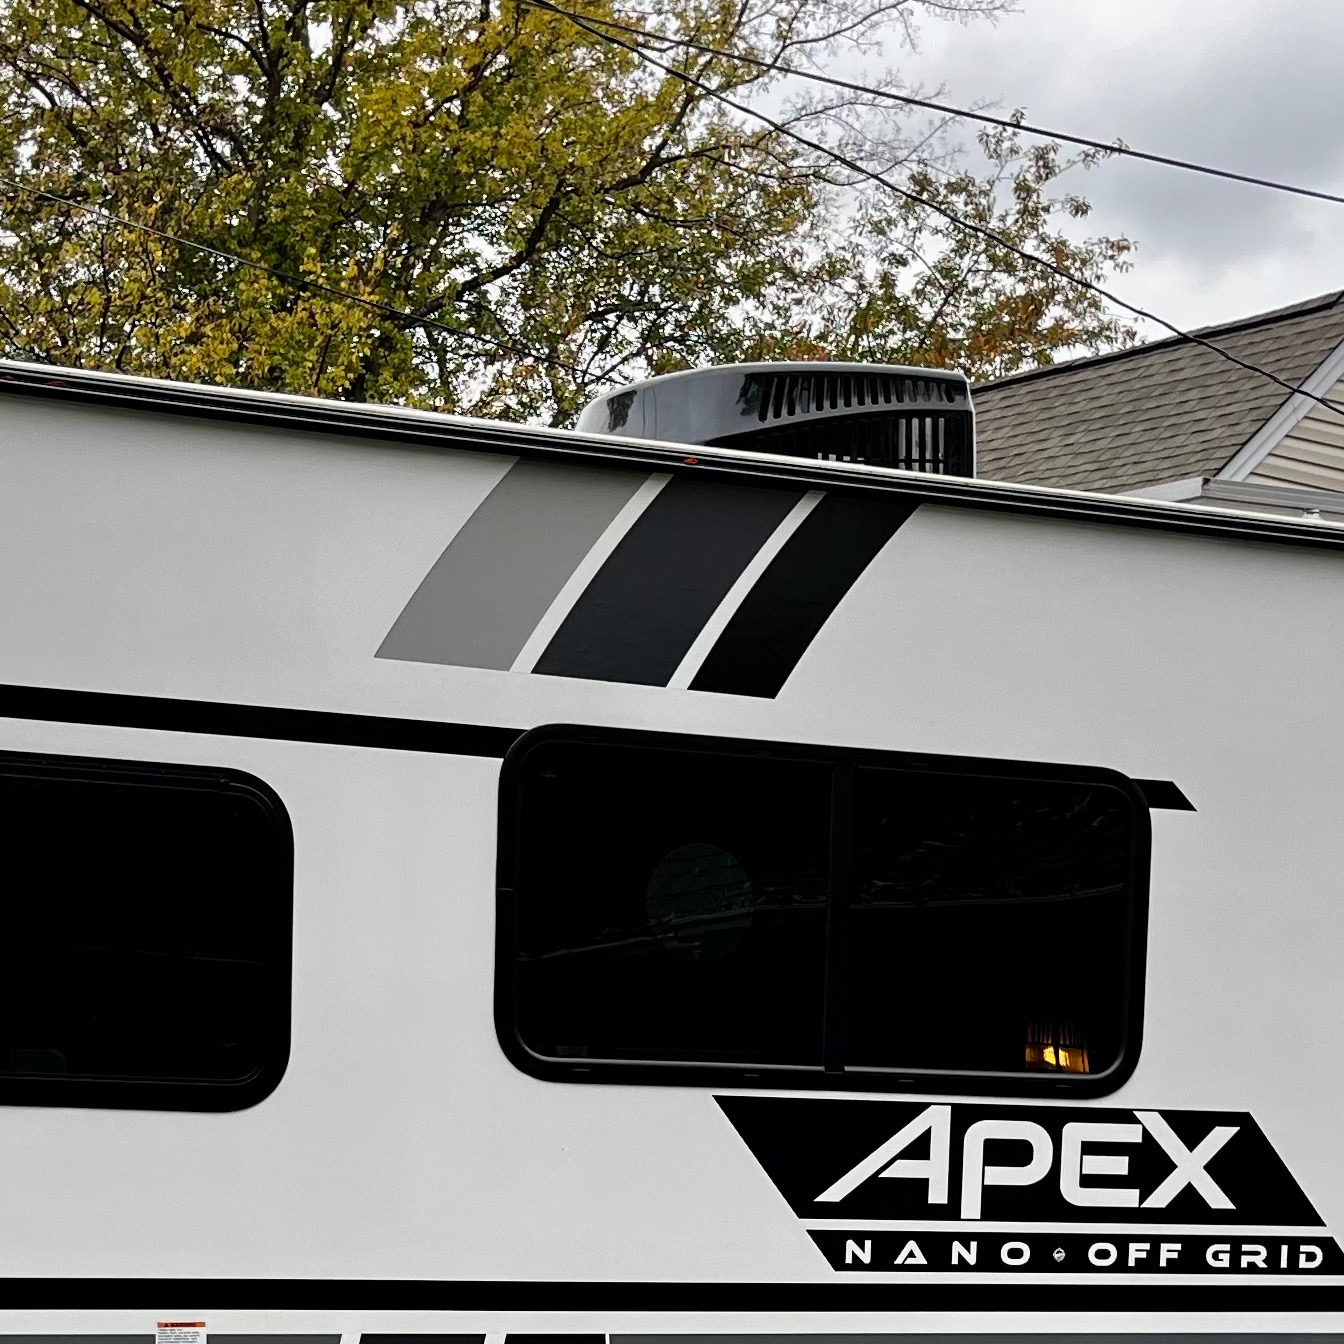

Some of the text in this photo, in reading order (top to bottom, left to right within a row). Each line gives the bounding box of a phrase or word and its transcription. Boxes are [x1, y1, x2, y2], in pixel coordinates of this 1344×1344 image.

[813, 1104, 1241, 1219] APEX
[845, 1239, 1324, 1269] NANO OFF GRID
